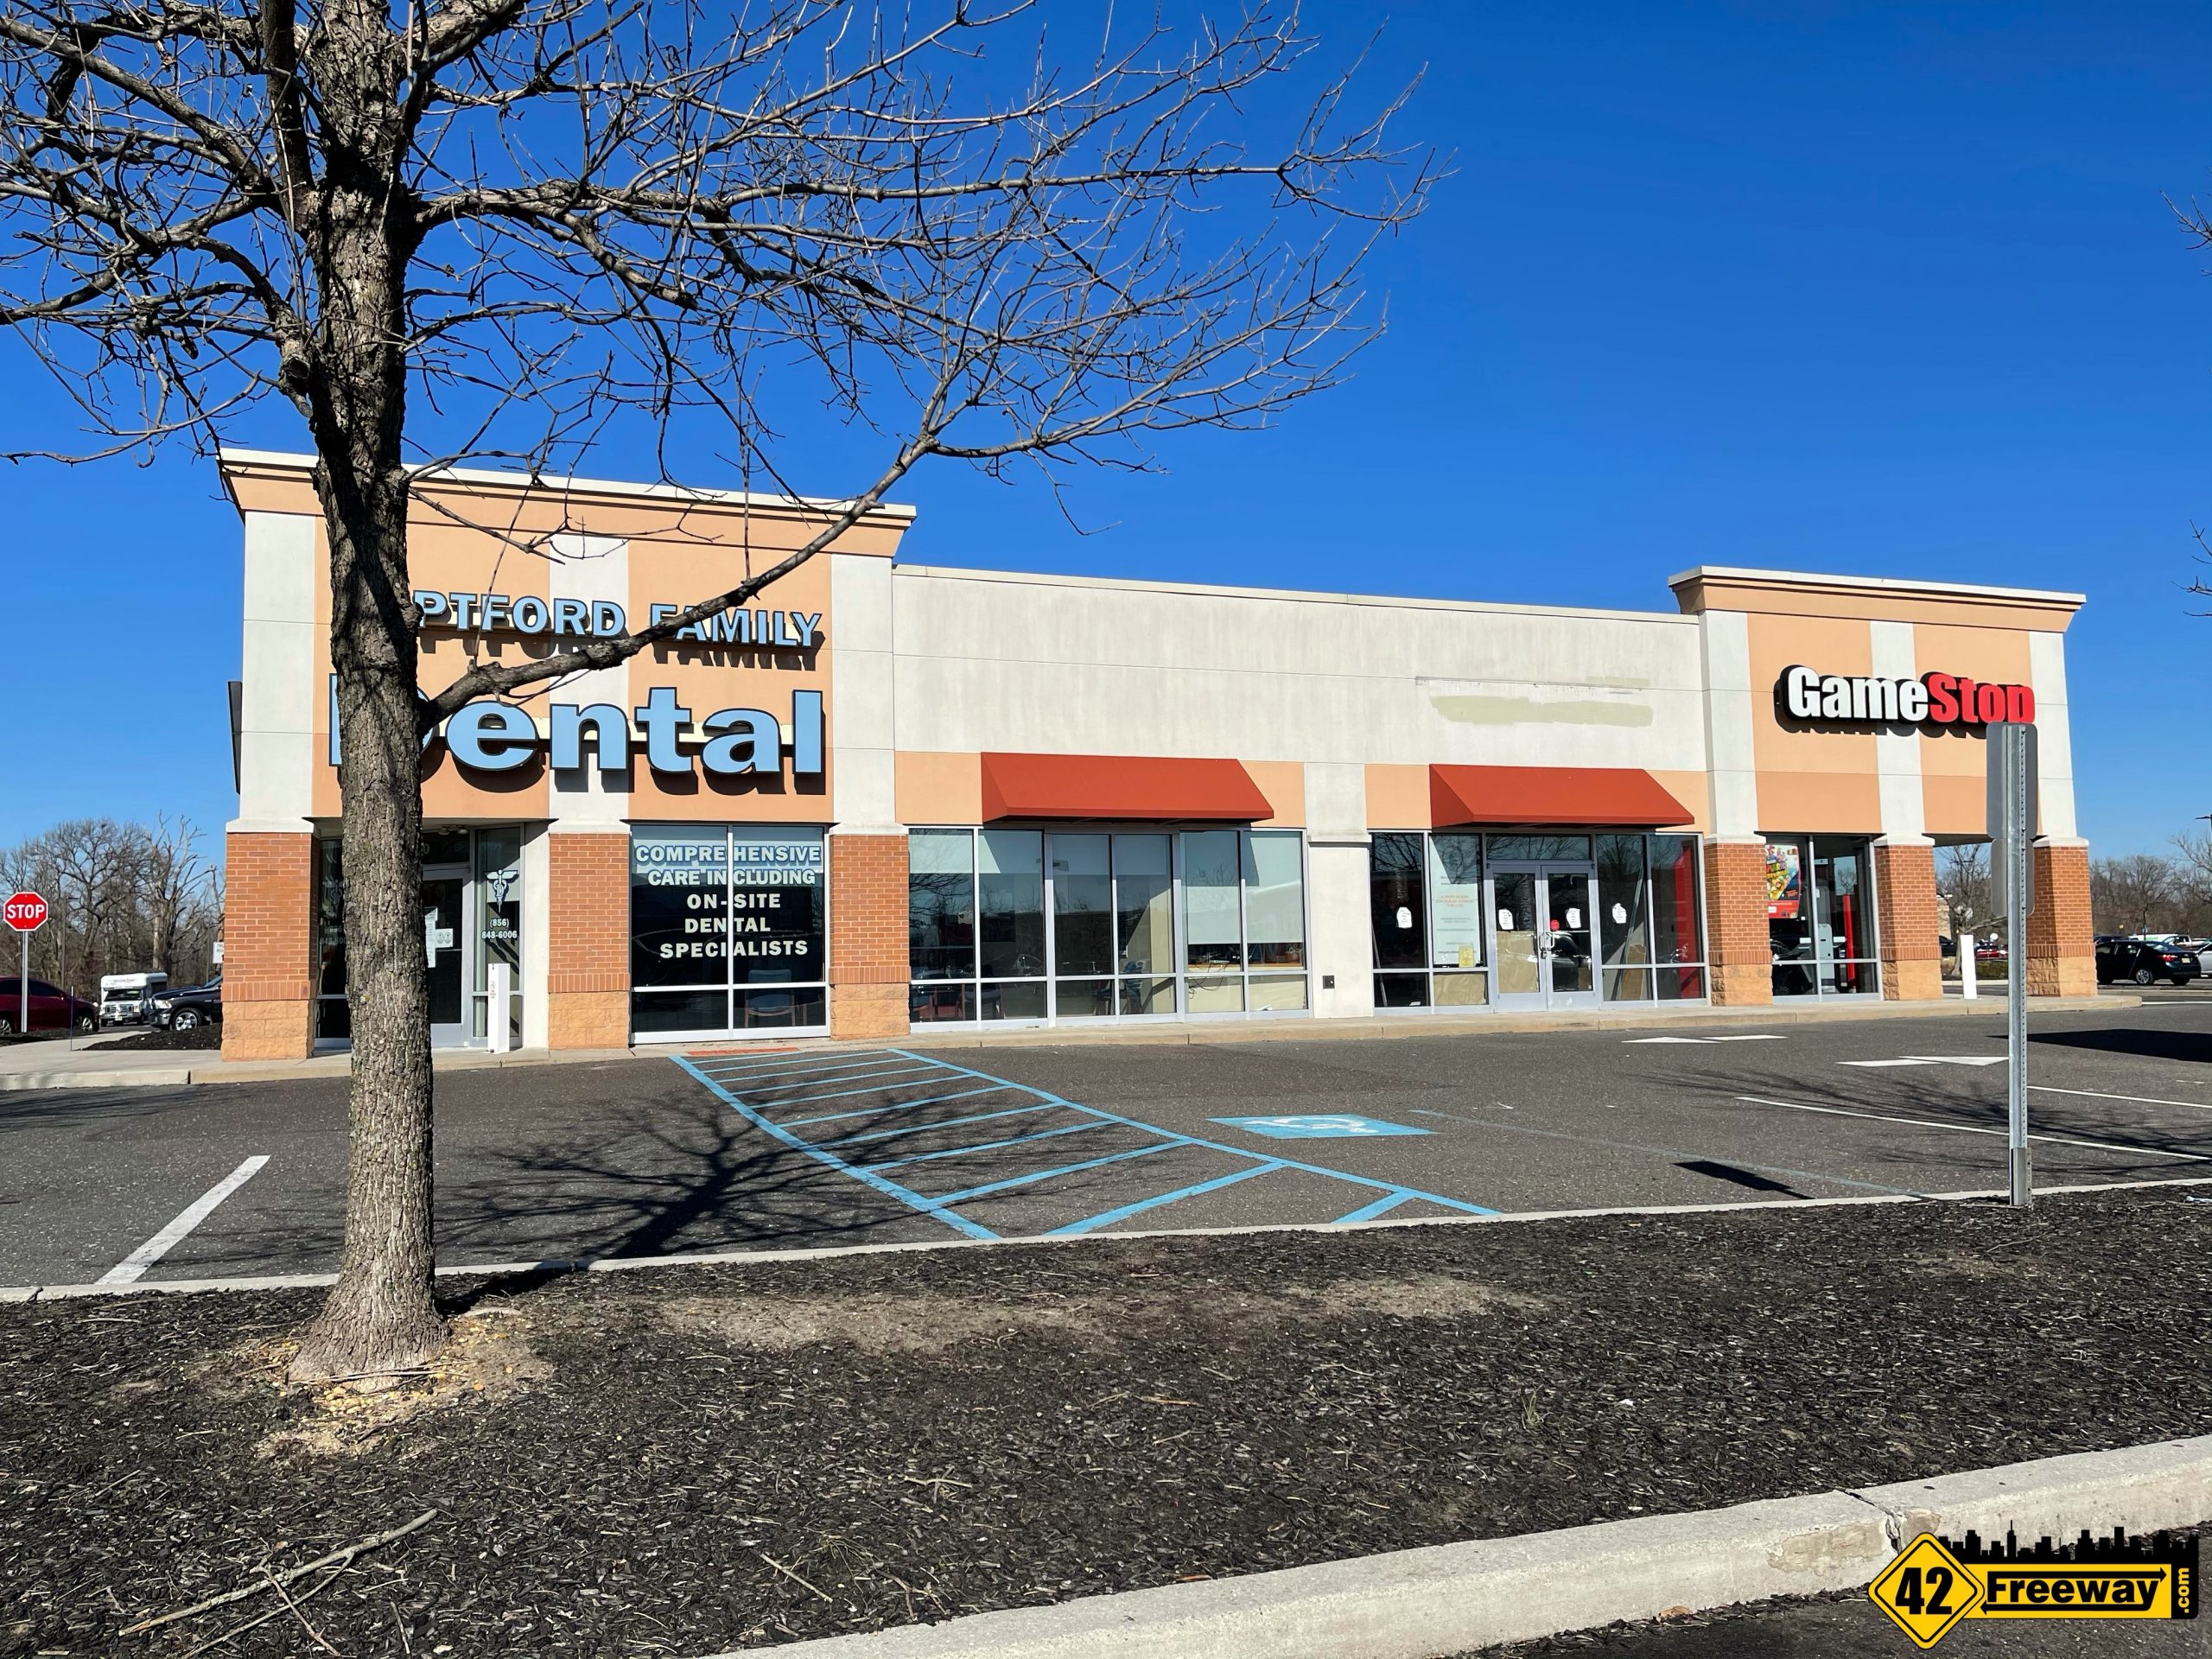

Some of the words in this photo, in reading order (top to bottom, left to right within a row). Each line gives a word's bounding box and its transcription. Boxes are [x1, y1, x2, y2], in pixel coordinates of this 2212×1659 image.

[413, 589, 626, 638] PTFORD
[650, 603, 823, 647] FAMILY
[1785, 666, 2036, 724] GameStop
[329, 673, 825, 774] ental
[635, 845, 821, 862] COMPREHENSIVE
[648, 869, 701, 886] CARE
[707, 869, 816, 886] INCLUDING
[687, 893, 781, 909] ON-SITE
[7, 904, 45, 919] STOP
[490, 918, 510, 928] (856)
[684, 917, 771, 933] DENTAL
[481, 930, 518, 939] 848-6006
[659, 940, 808, 959] SPECIALISTS
